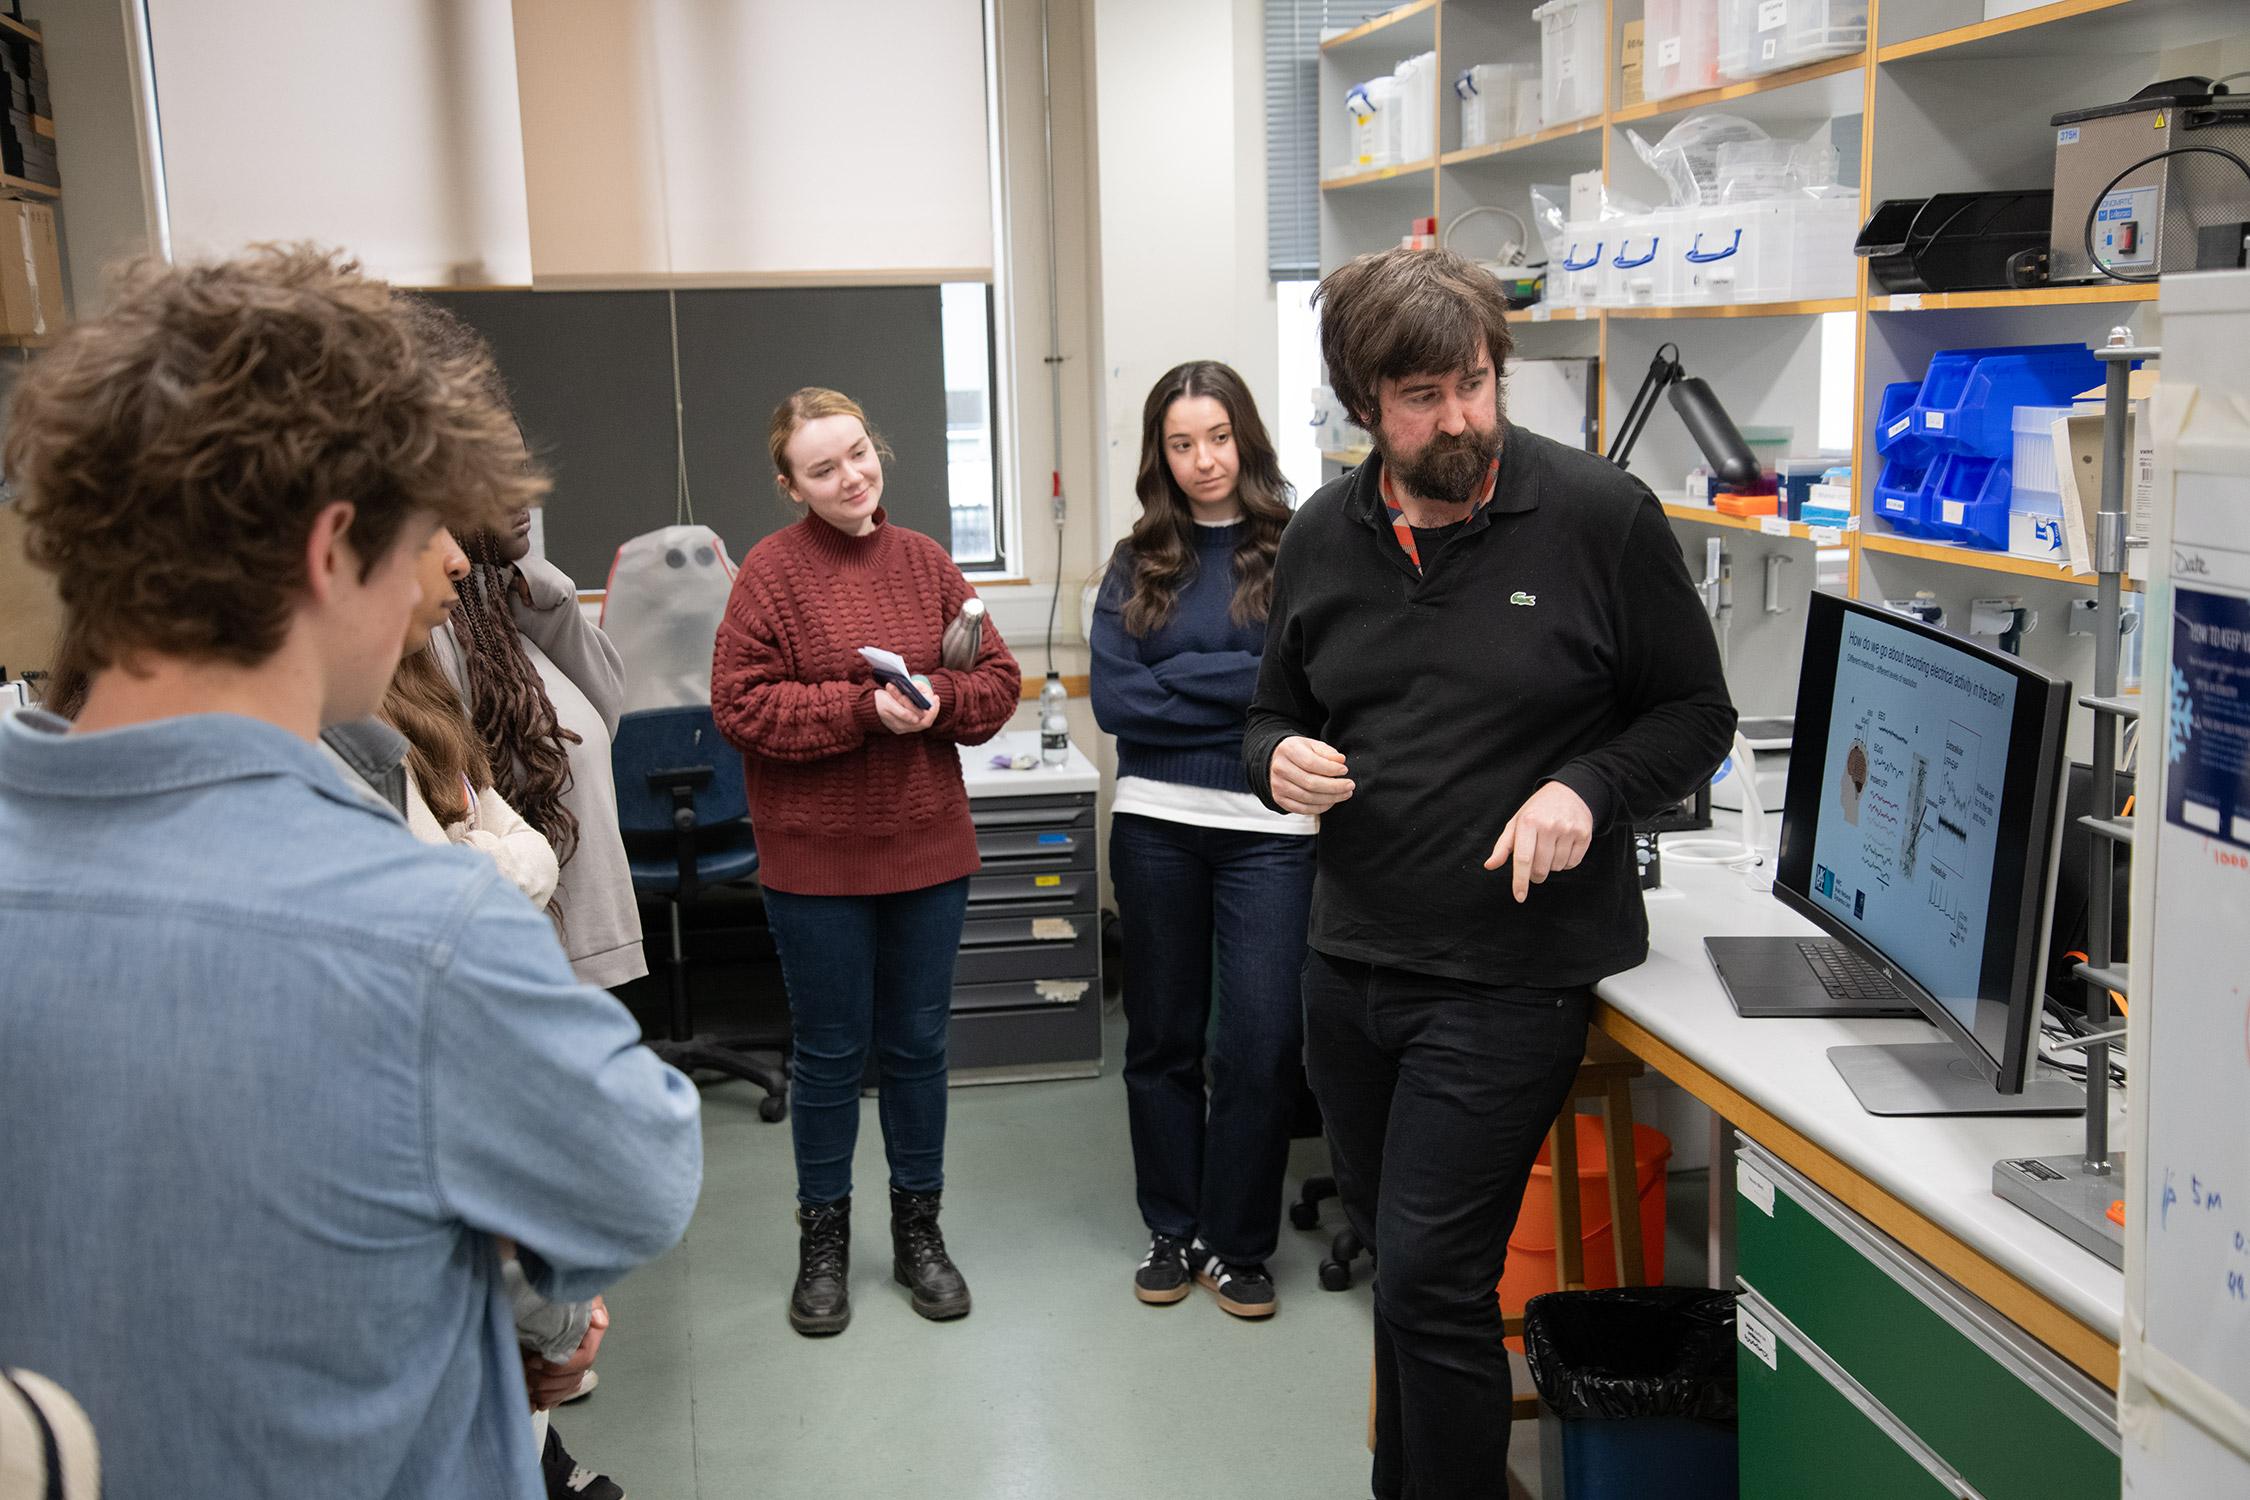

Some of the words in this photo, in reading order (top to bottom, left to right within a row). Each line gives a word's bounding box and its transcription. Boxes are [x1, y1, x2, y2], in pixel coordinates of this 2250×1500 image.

[2175, 550, 2210, 575] Date
[2192, 623, 2208, 644] HOW
[2210, 626, 2220, 647] TO
[2222, 628, 2241, 650] KEEP
[1849, 631, 1862, 647] How
[1862, 635, 1871, 650] do
[1871, 641, 1879, 654] we
[1879, 646, 1887, 661] go
[1888, 646, 1904, 664] about
[1905, 654, 1929, 678] recording
[1930, 664, 1952, 684] electrical
[1954, 674, 1972, 696] activity
[1979, 684, 1987, 700] the
[1988, 688, 2004, 709] brain?
